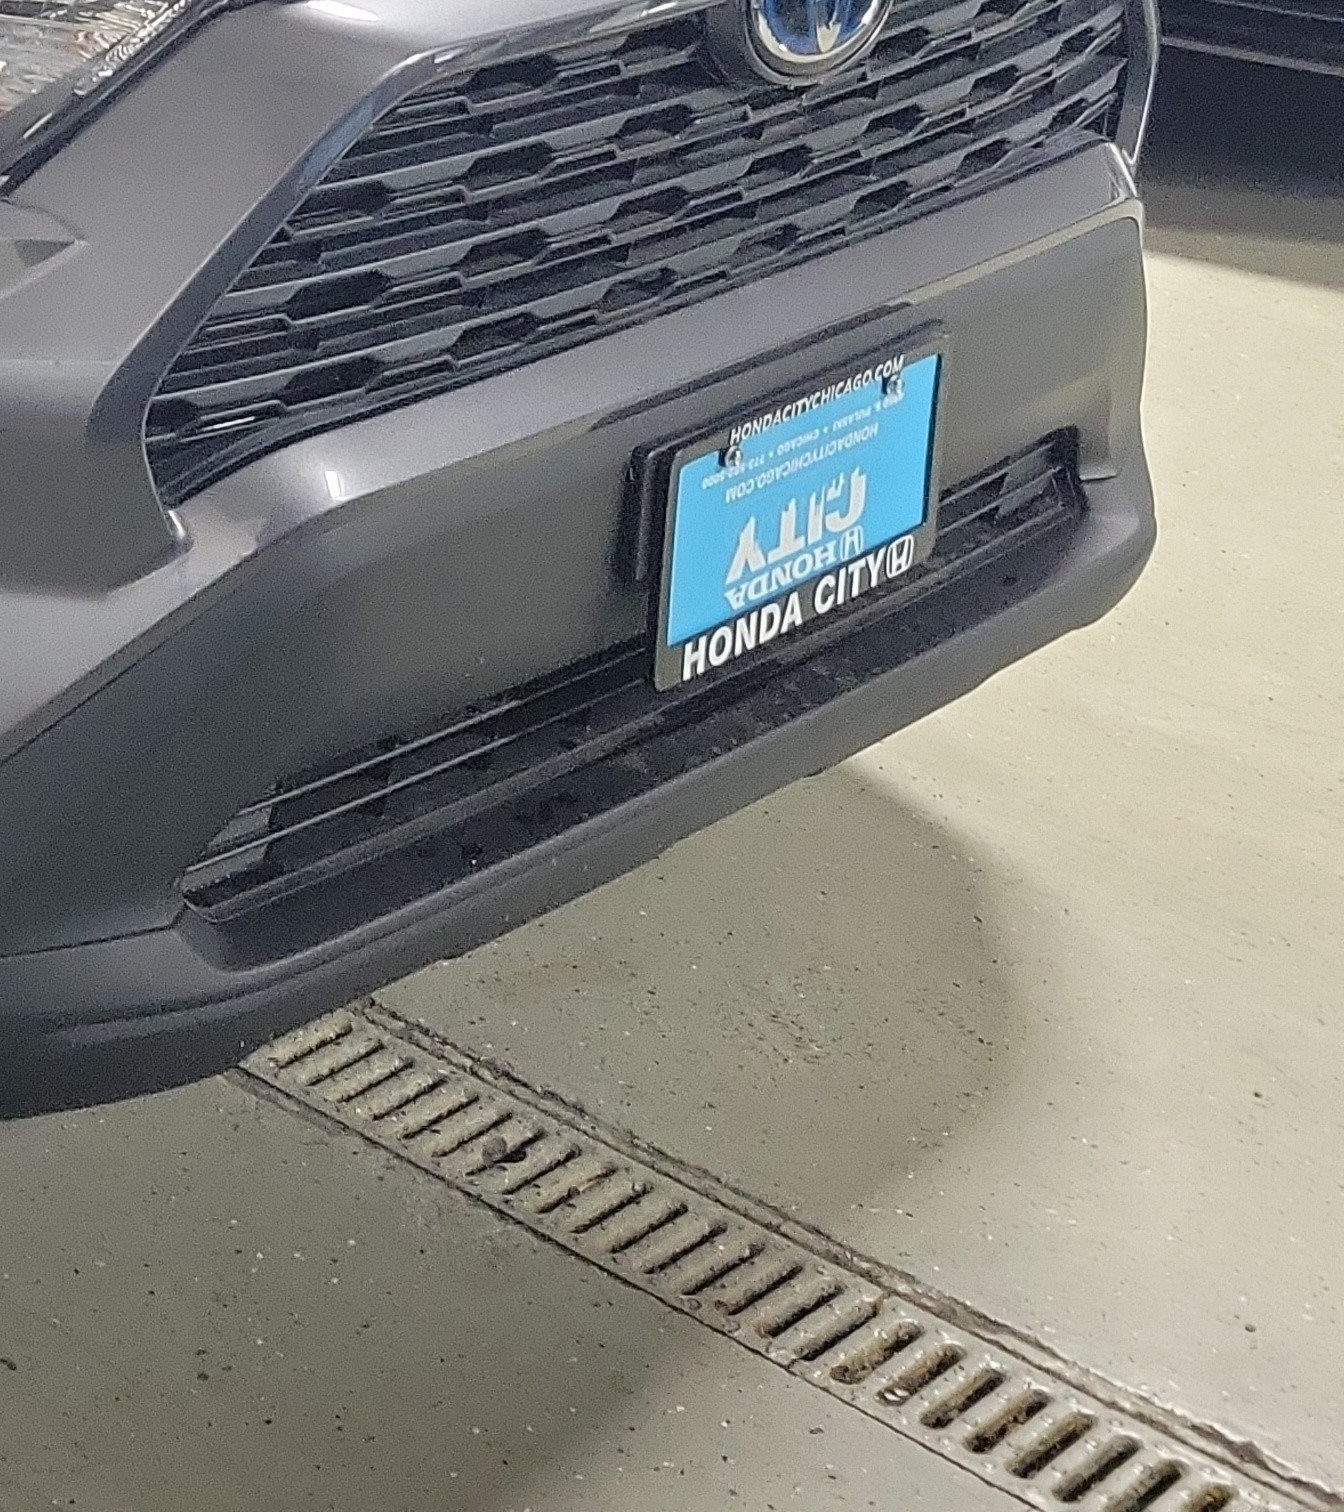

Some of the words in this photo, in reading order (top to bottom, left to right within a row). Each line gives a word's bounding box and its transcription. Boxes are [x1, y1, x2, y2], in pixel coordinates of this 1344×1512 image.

[730, 354, 905, 446] HONDACITYCHICAGO.COM
[777, 429, 820, 457] CHICAGO
[725, 422, 880, 504] HONDACITYCHICAGO.COM
[725, 466, 867, 585] CITY
[682, 592, 802, 682] HONDA
[814, 544, 888, 615] CITY
[723, 540, 837, 611] HONDA
